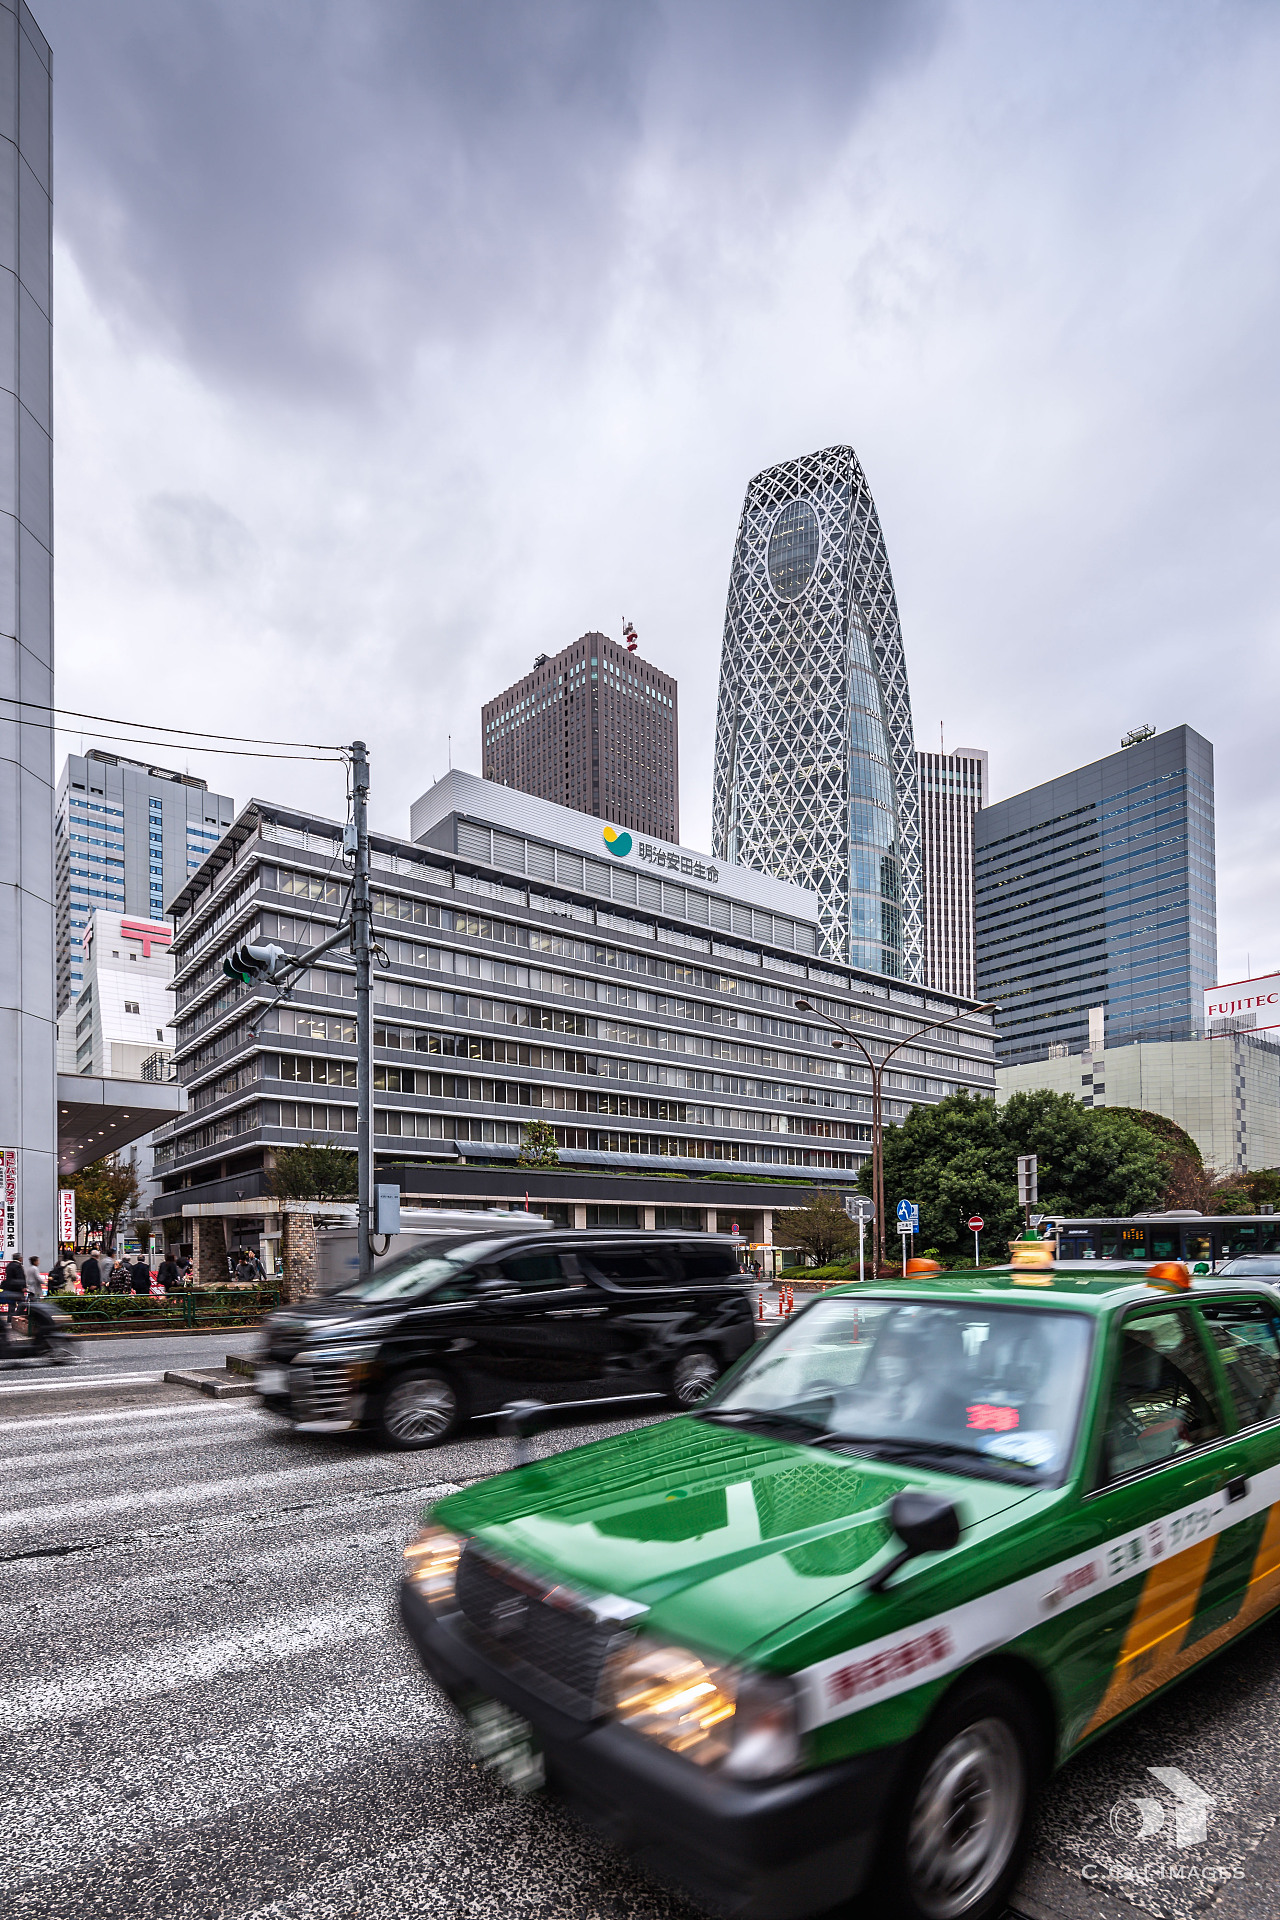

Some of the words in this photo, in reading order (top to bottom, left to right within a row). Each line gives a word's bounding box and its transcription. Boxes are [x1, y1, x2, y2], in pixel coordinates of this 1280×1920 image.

[638, 841, 720, 884] 明治安田生命
[1208, 992, 1279, 1016] FUJITEC
[64, 1193, 73, 1240] ヨドバシカメラ
